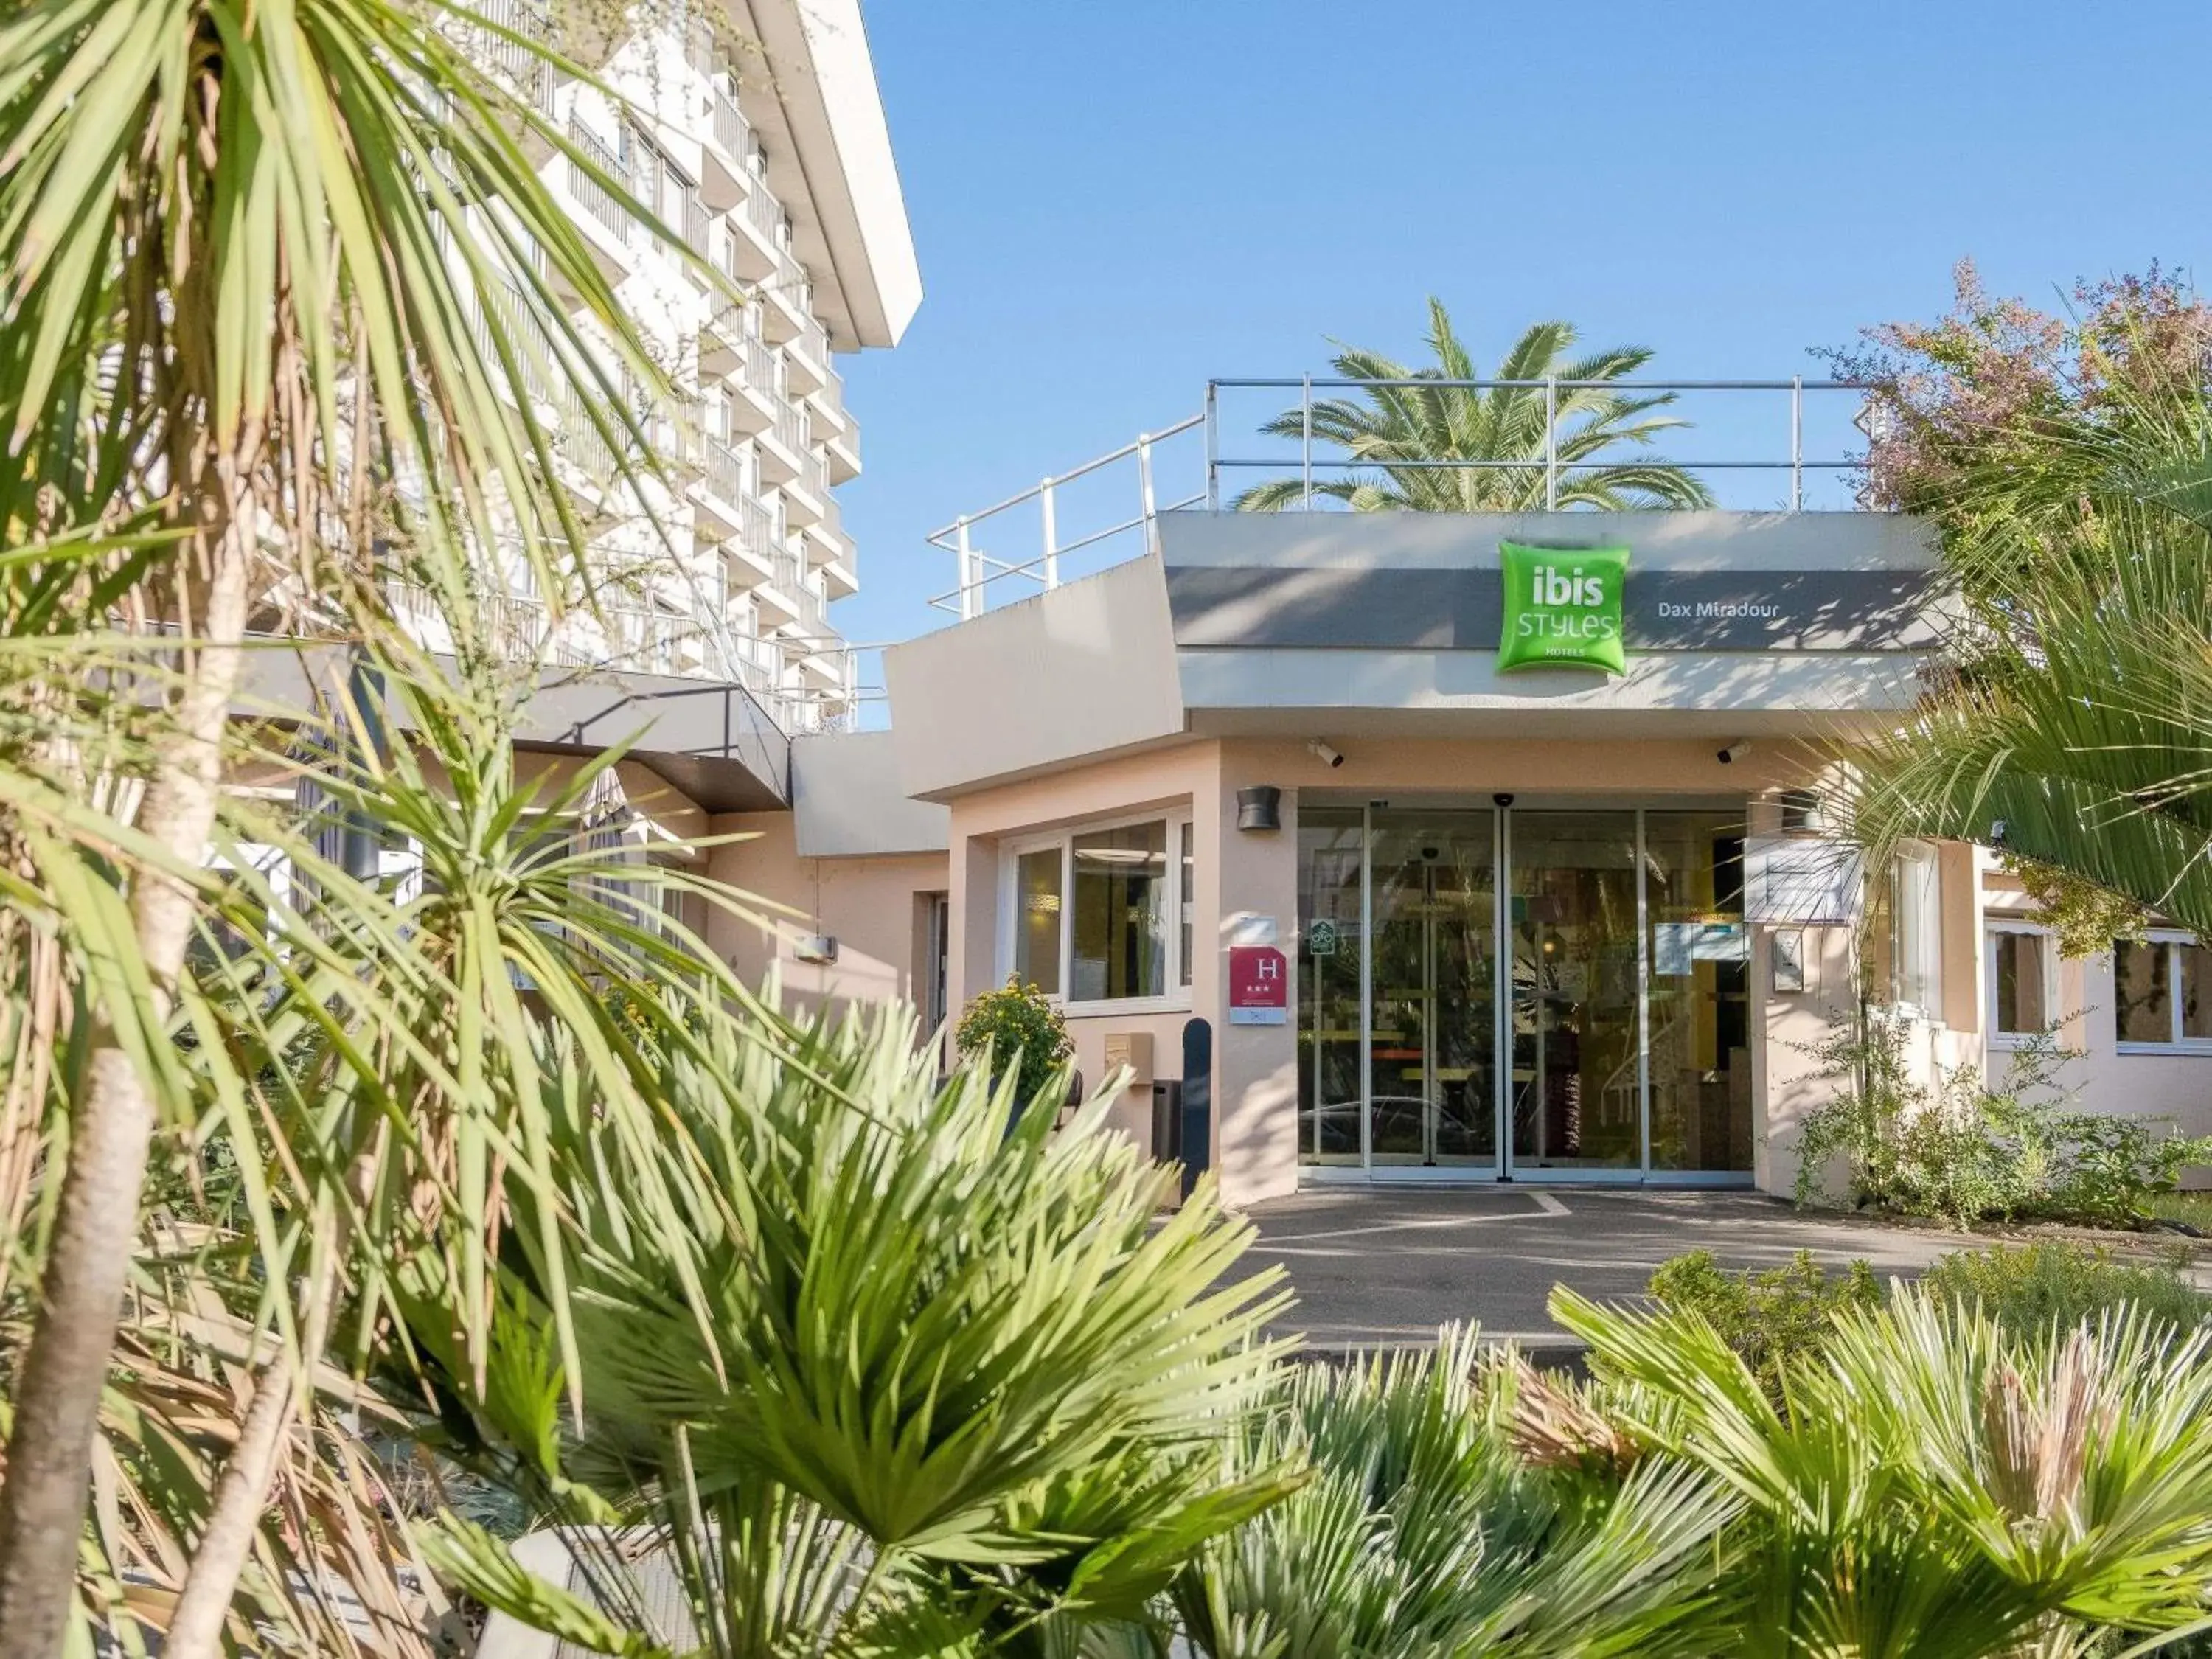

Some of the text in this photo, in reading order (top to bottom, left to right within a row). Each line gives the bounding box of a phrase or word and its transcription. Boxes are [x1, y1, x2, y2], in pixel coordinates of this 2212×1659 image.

[1533, 566, 1604, 606] ibis
[1658, 601, 1780, 617] Dax Miradour
[1545, 648, 1585, 656] HOTELS
[1257, 958, 1279, 980] H
